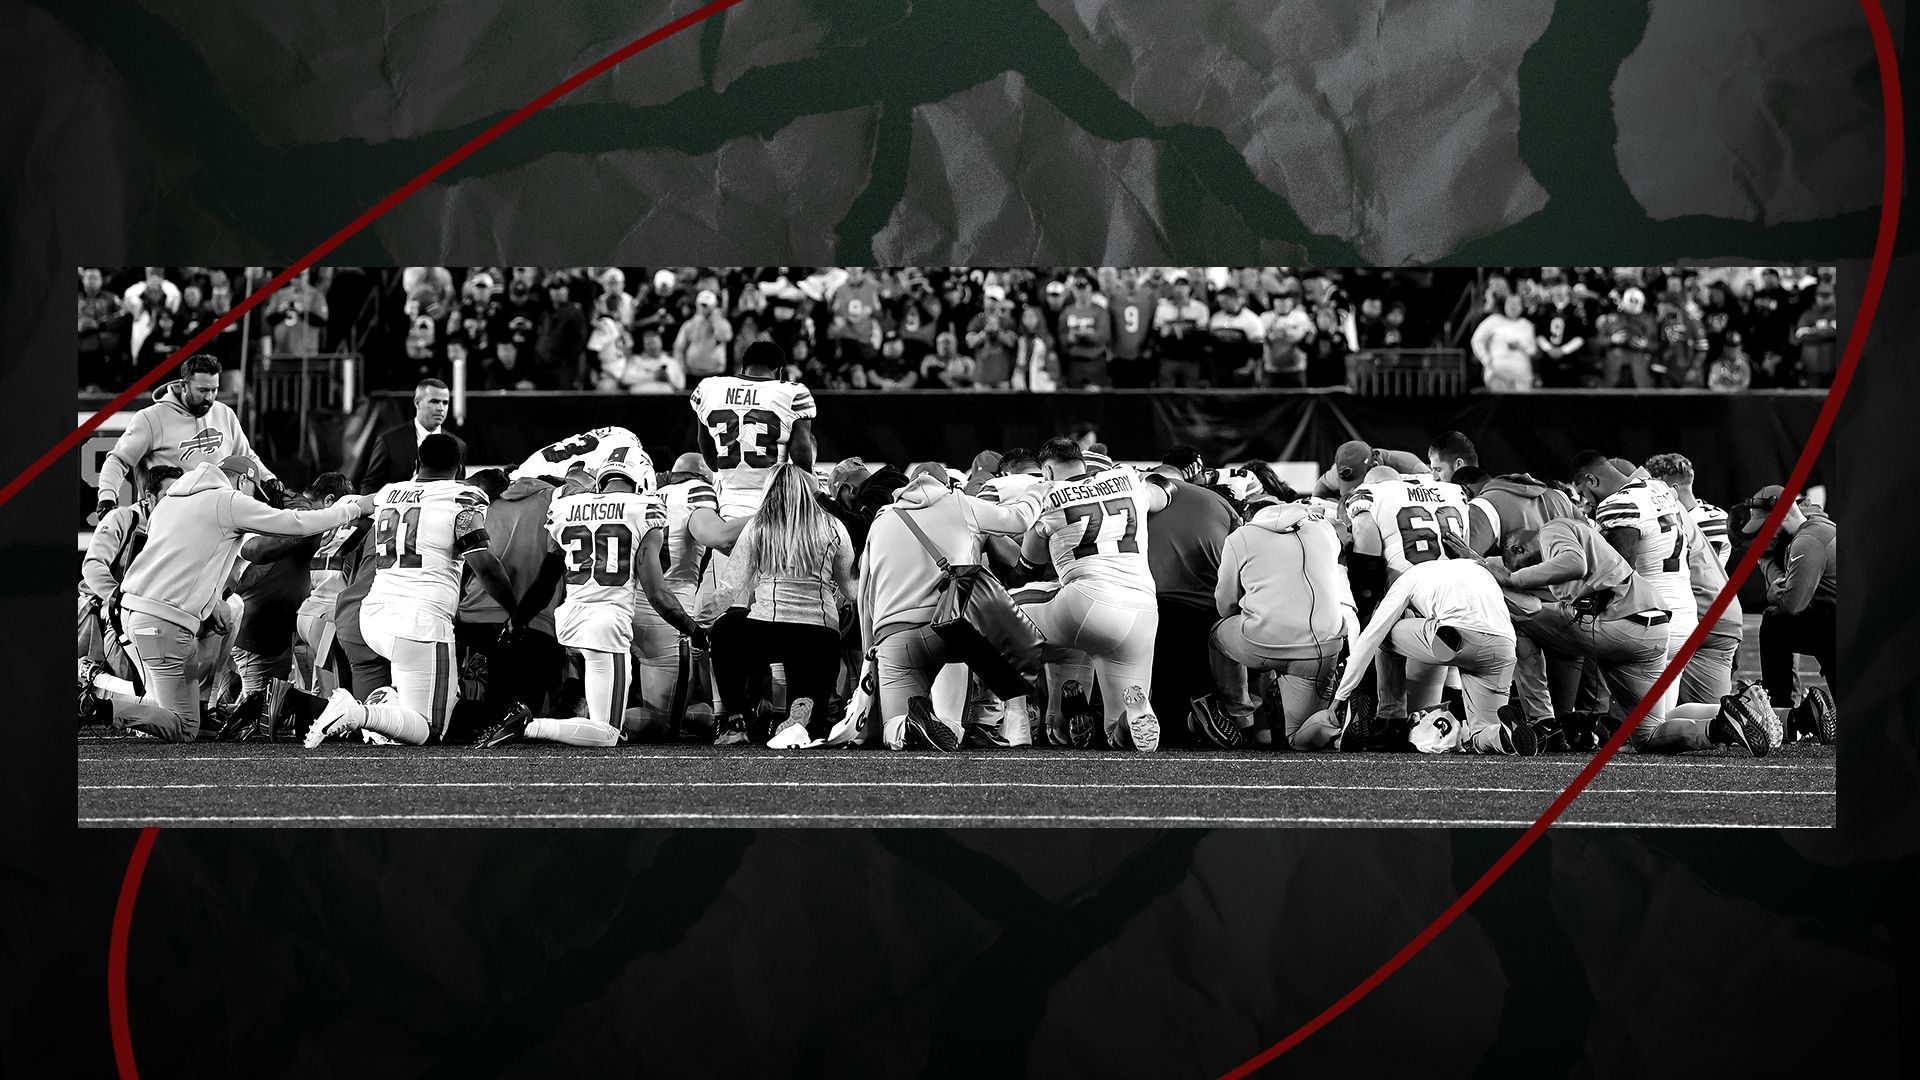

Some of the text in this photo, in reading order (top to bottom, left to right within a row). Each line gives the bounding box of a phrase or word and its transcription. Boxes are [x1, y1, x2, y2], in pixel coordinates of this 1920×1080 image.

[1124, 306, 1140, 333] 9
[725, 387, 760, 406] NEAL
[706, 408, 781, 470] 33
[386, 489, 424, 504] OLIVER
[1049, 475, 1133, 508] QUESSENBERRY
[1406, 487, 1446, 503] MORSE
[565, 502, 626, 522] JACKSON
[1063, 496, 1140, 561] 77
[376, 506, 423, 569] 91
[1396, 505, 1464, 566] 60
[561, 523, 632, 587] 30
